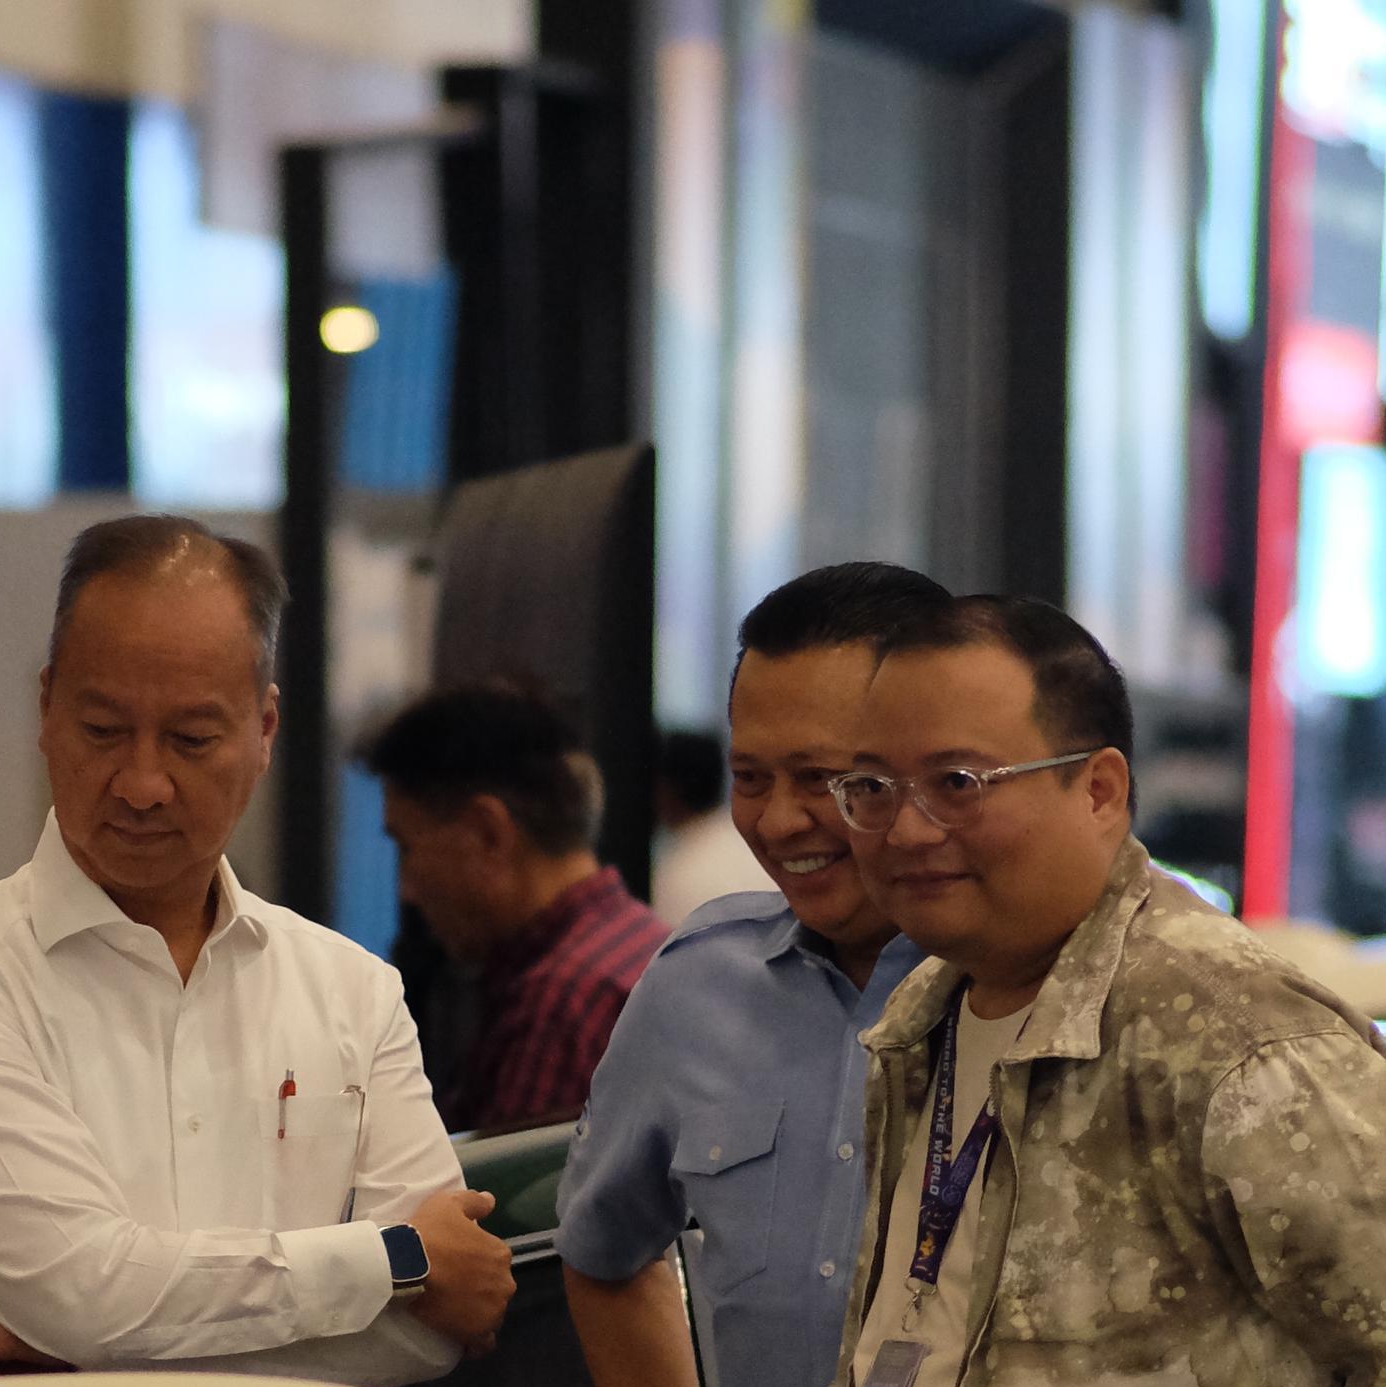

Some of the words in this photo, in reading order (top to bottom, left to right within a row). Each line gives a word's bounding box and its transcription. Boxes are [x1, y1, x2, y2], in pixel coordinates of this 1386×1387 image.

[939, 1078, 949, 1097] TO
[935, 1103, 947, 1134] THE
[928, 1139, 944, 1197] WORLD
